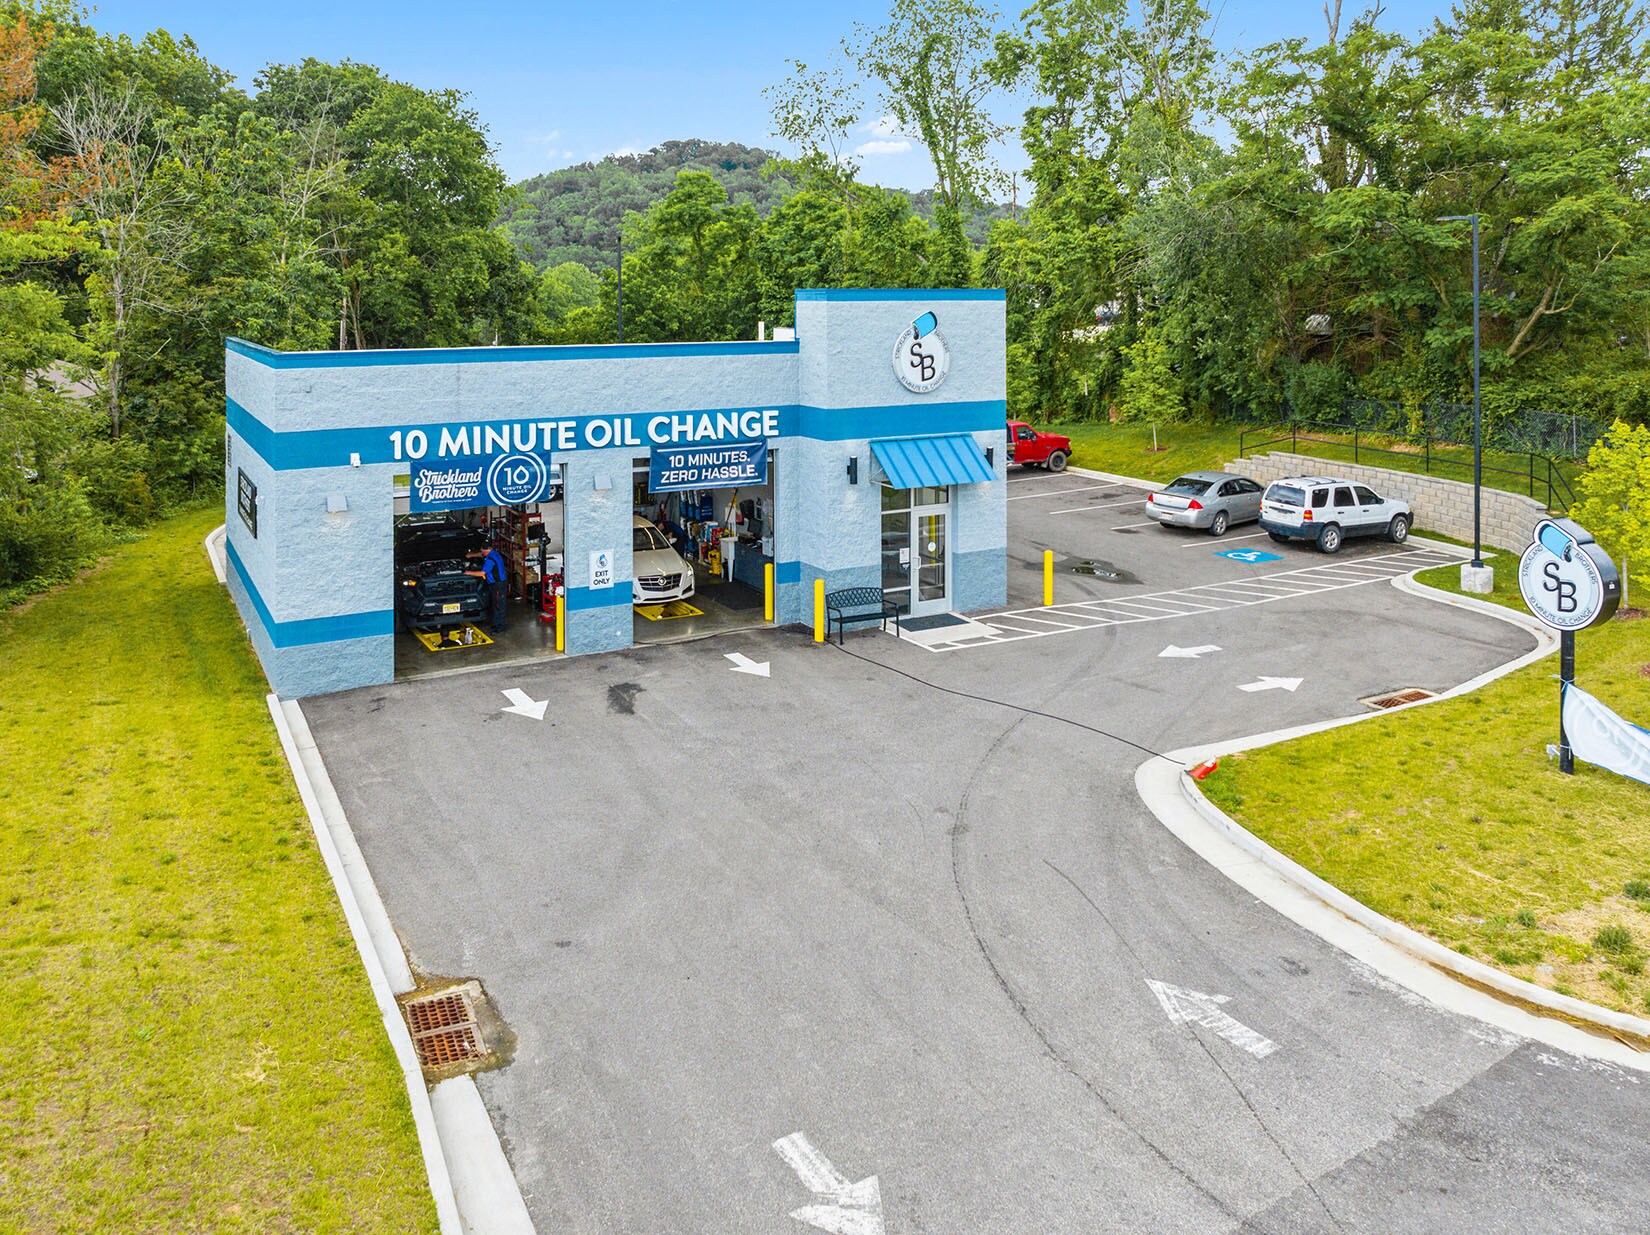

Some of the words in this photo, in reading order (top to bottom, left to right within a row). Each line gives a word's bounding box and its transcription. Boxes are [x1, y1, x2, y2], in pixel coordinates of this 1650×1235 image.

[910, 342, 936, 381] SB
[389, 429, 428, 460] 10
[438, 420, 577, 457] MINUTE
[584, 417, 641, 447] OIL
[647, 410, 780, 444] CHANGE
[669, 455, 685, 468] 10
[688, 450, 751, 467] MINUTES.
[414, 466, 483, 488] Strickland
[504, 464, 530, 486] 10
[660, 470, 698, 484] ZERO
[701, 464, 759, 480] HASSLE.
[418, 484, 479, 503] Brothers
[1522, 544, 1544, 577] STRICKLAND
[1575, 552, 1599, 585] BROTHERS
[593, 578, 610, 586] ONLY
[1543, 562, 1578, 613] SB
[1535, 603, 1556, 622] MINUTE
[1557, 617, 1568, 625] OIL
[1569, 607, 1592, 625] CHANGE
